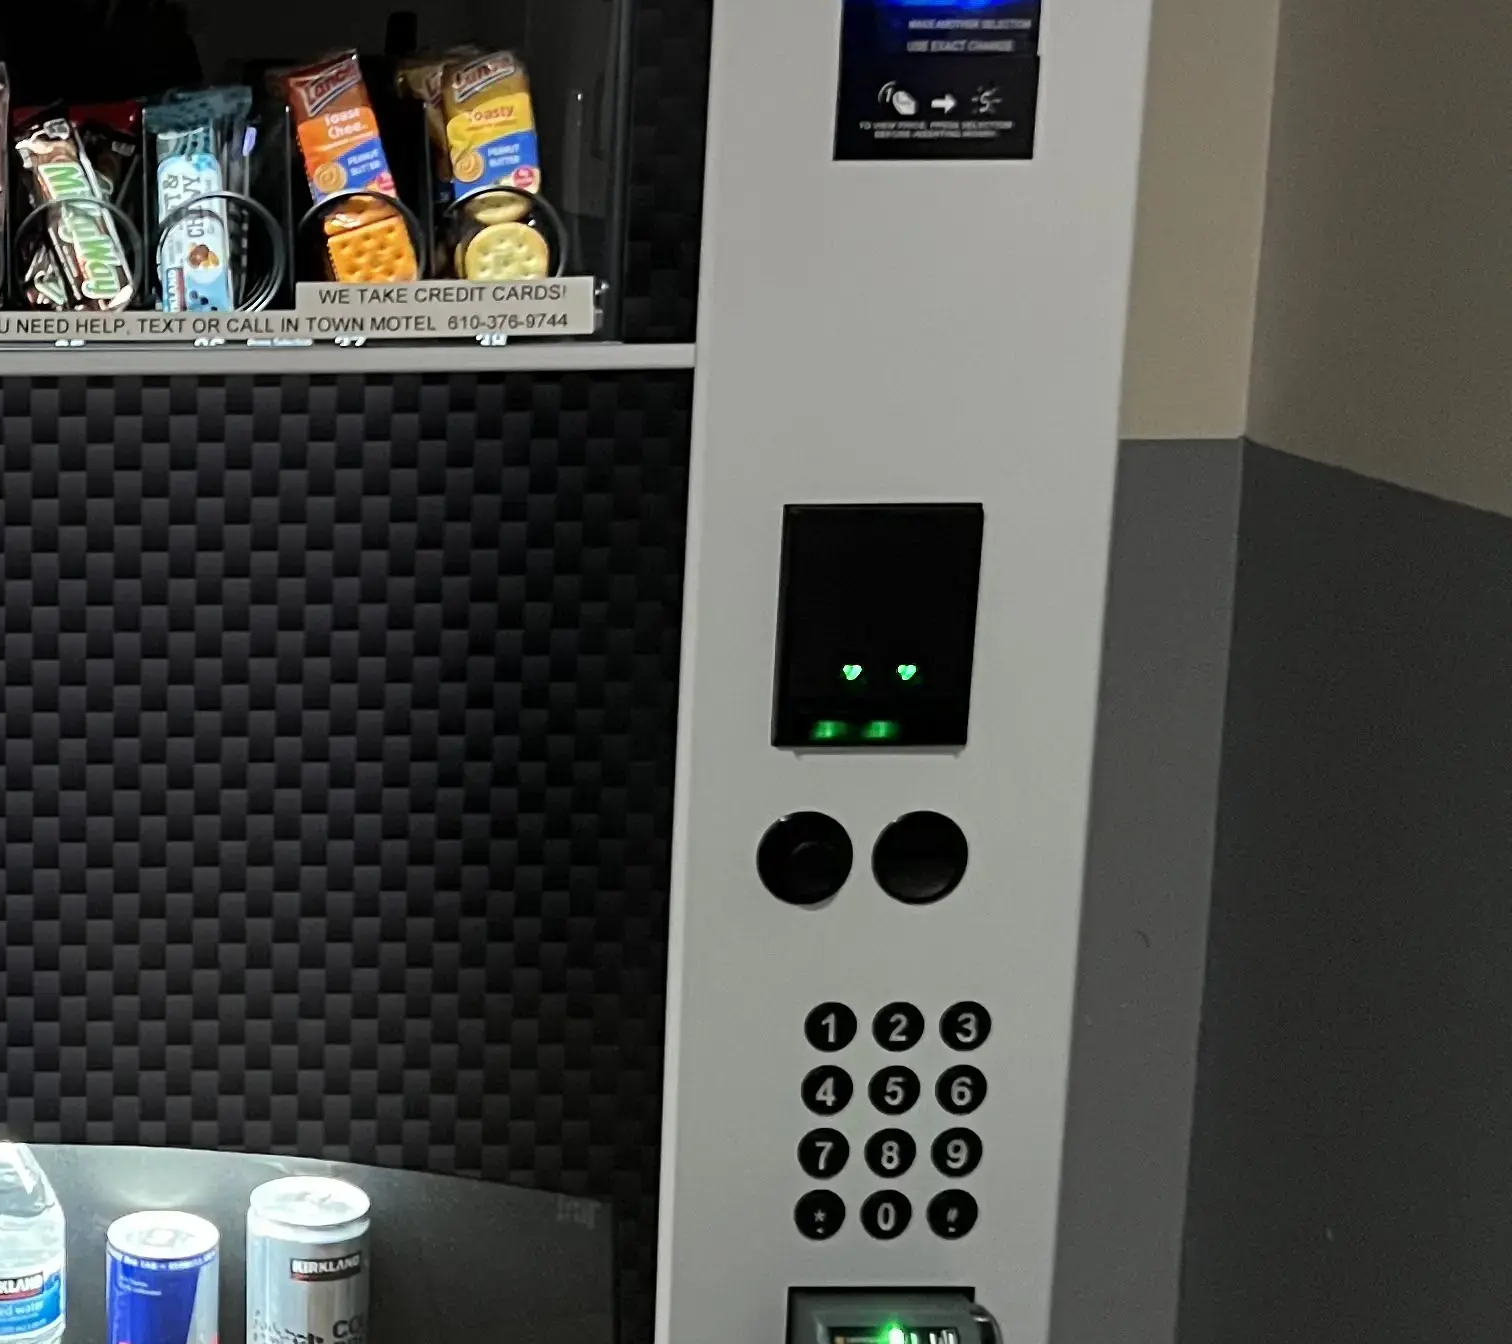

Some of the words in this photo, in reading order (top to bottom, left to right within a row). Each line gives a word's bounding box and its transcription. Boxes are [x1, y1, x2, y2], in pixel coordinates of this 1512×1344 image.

[319, 289, 349, 305] WE
[356, 288, 407, 304] TAKE
[414, 286, 485, 303] CREDIT
[492, 284, 567, 301] CARDS!
[16, 318, 69, 334] NEED
[136, 318, 187, 333] TEXT
[192, 317, 220, 333] OR
[226, 317, 274, 333] CALL
[281, 317, 298, 332] IN
[306, 317, 365, 333] TOWN
[370, 315, 436, 331] MOTEL
[447, 313, 569, 330] 610-376-9744
[821, 1012, 836, 1043] 1
[888, 1013, 908, 1042] 2
[955, 1012, 978, 1043] 3
[815, 1076, 836, 1106] 4
[883, 1076, 904, 1106] 5
[950, 1076, 973, 1106] 6
[815, 1141, 834, 1171] 7
[880, 1140, 901, 1170] 8
[946, 1139, 968, 1169] 9
[877, 1202, 896, 1231] 0
[292, 1254, 360, 1273] KIRKLAND
